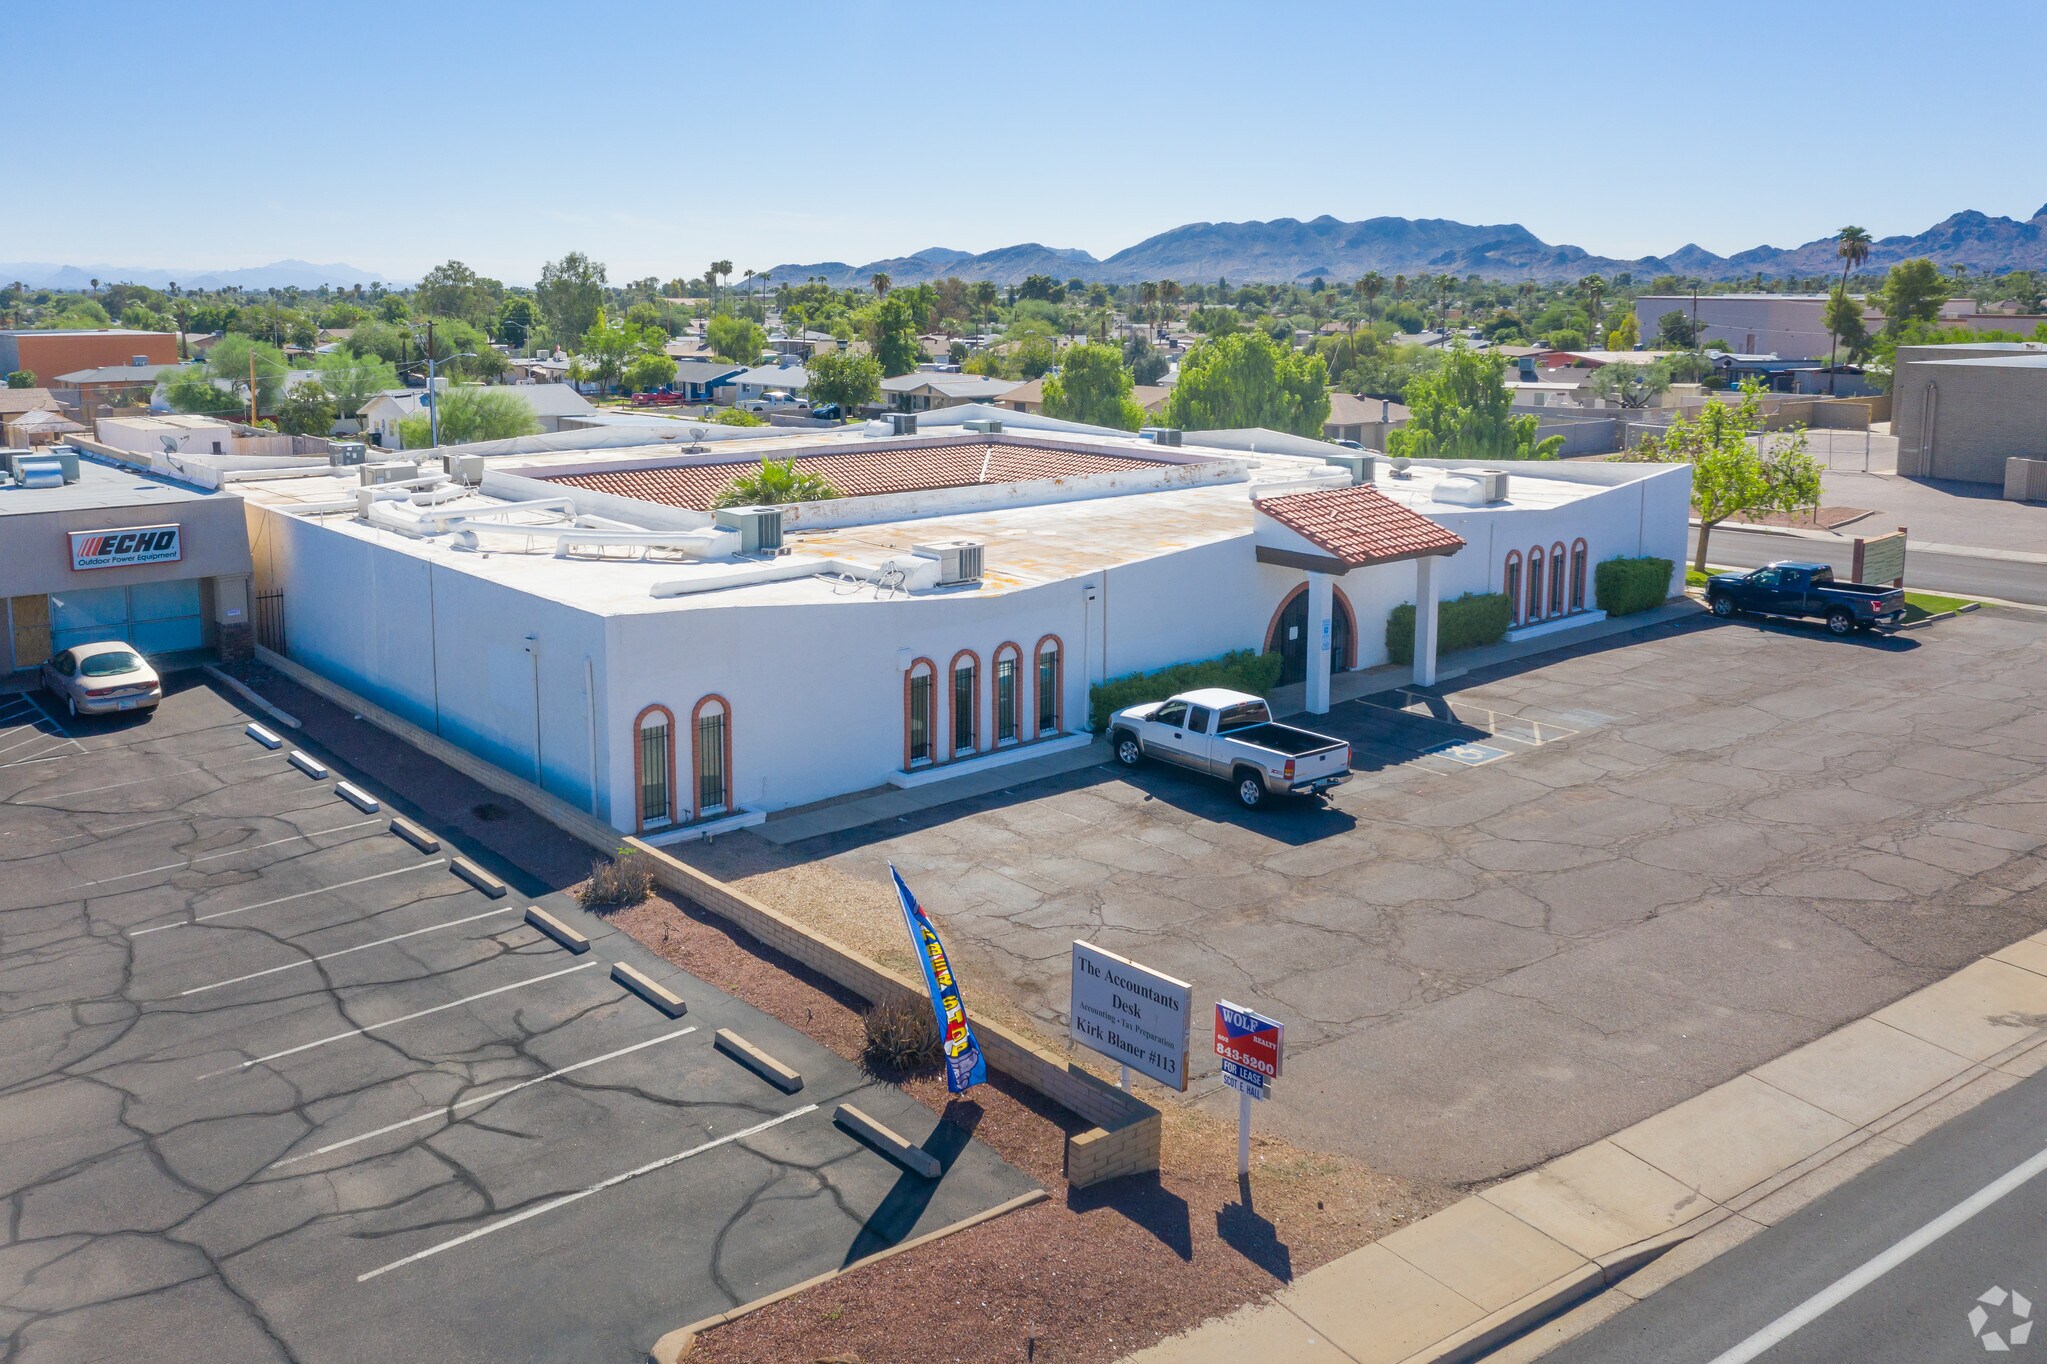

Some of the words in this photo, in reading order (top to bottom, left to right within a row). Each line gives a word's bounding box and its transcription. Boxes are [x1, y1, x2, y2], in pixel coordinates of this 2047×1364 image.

[98, 531, 176, 555] ECHO
[78, 558, 110, 567] Outdoor
[112, 555, 135, 563] Power
[137, 551, 177, 561] Equipment
[1078, 956, 1100, 977] The
[1104, 969, 1179, 1011] Accountants
[1112, 993, 1142, 1019] Desk
[1080, 1002, 1116, 1024] Accounting
[1121, 1019, 1133, 1030] Tax
[1135, 1025, 1175, 1049] Preparation
[1222, 1008, 1258, 1032] WOLF
[1076, 1016, 1104, 1040] Kirk
[1108, 1030, 1146, 1059] Blaner
[1148, 1050, 1176, 1074] #113
[1253, 1036, 1277, 1050] REALTY
[1216, 1043, 1274, 1075] 843-5200
[1223, 1060, 1238, 1075] FOR
[1240, 1067, 1262, 1085] LEASE
[1247, 1086, 1260, 1099] HALL
